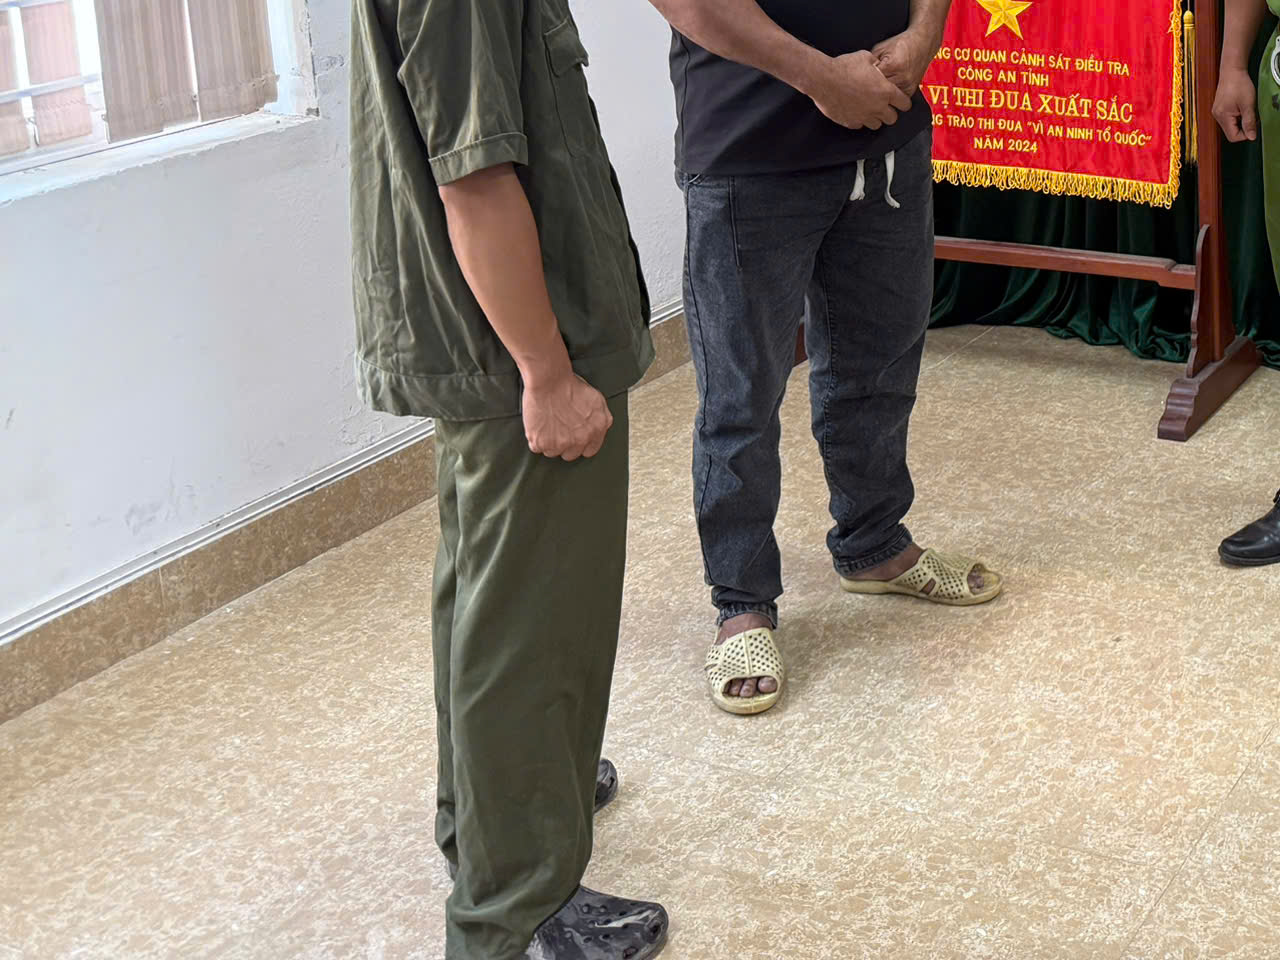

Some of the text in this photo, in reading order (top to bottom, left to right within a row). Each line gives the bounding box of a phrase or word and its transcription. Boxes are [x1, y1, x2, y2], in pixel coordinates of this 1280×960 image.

[954, 47, 970, 61] CƠ
[973, 47, 1007, 63] QUAN
[1010, 47, 1045, 68] CẢNH
[1048, 53, 1071, 71] SÁT
[1075, 53, 1104, 73] ĐIỀU
[1107, 60, 1130, 77] TRA
[957, 65, 1049, 87] CÔNG AN TỈNH
[927, 84, 1133, 124] VỊ THI ĐUA XUẤT SẮC
[947, 112, 975, 129] TRÀO
[978, 117, 995, 130] THI
[997, 118, 1023, 133] ĐUA
[1046, 124, 1063, 138] AN
[1066, 126, 1093, 141] NINH
[1096, 125, 1111, 142] TỔ
[973, 134, 1038, 153] NĂM 2024
